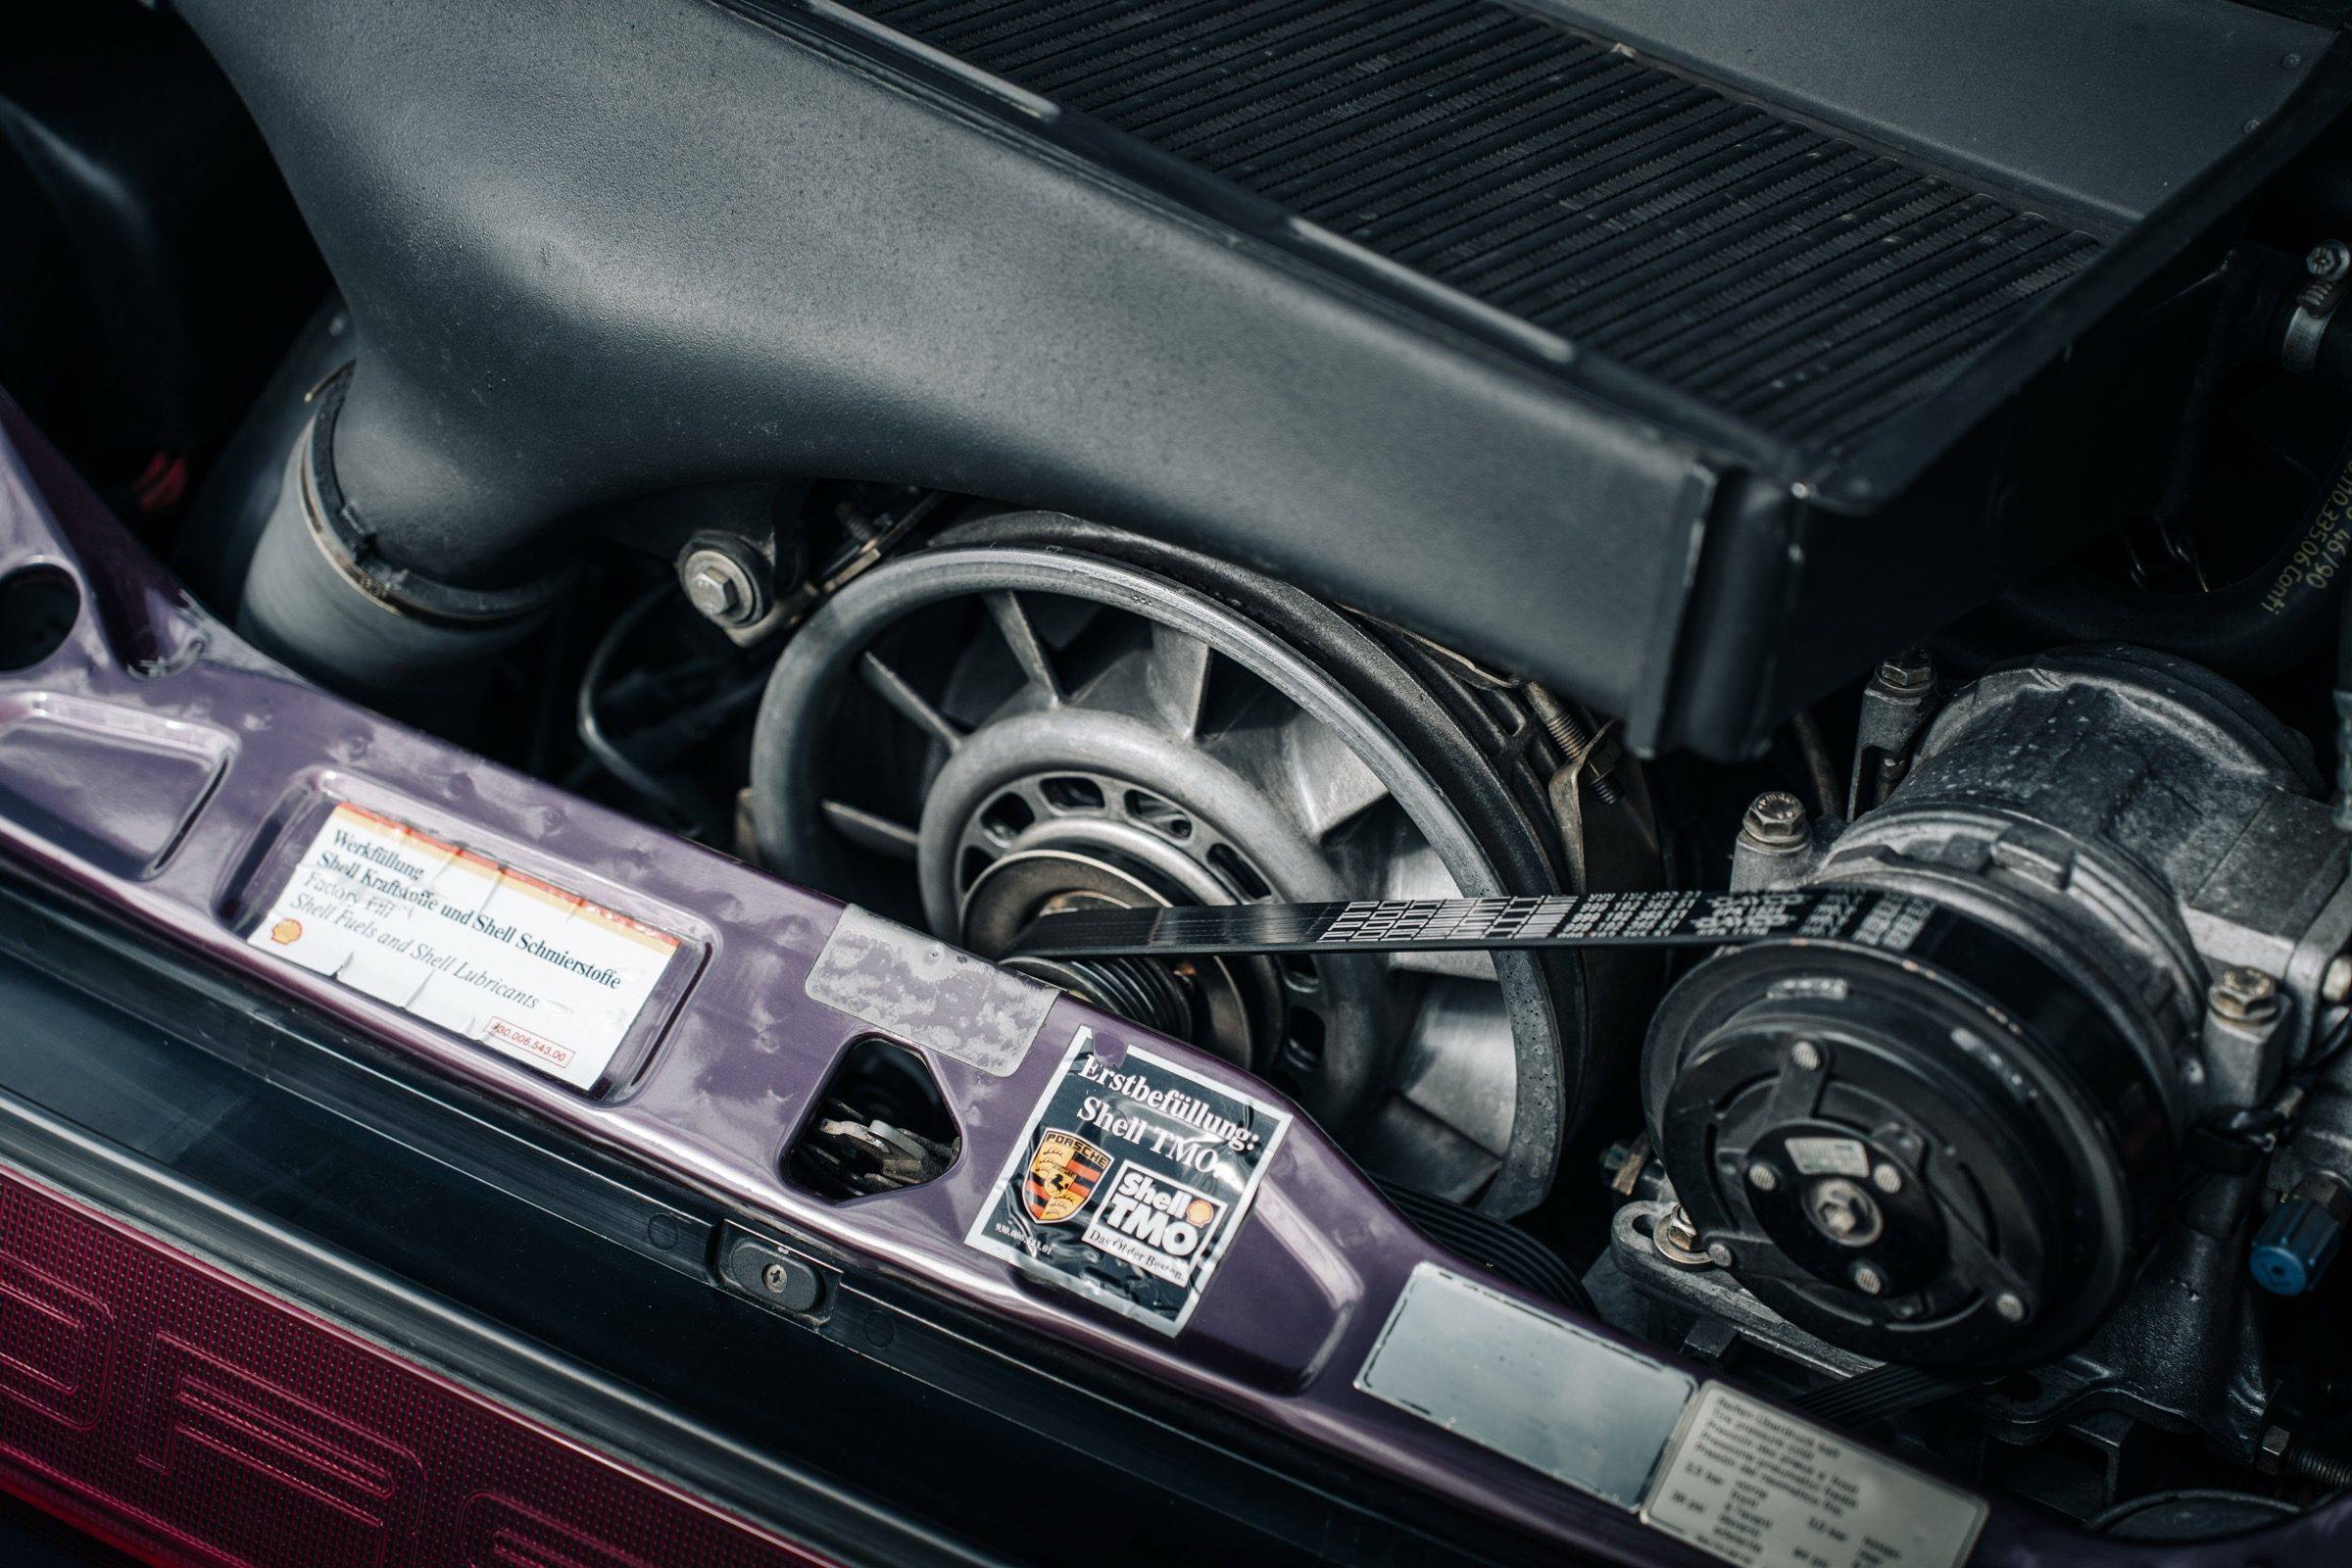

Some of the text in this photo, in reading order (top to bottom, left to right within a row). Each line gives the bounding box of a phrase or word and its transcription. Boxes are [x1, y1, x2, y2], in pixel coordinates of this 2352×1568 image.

[2306, 528, 2350, 589] 46/90
[2261, 565, 2302, 615] Conti
[332, 829, 425, 881] Werkfüllung
[317, 852, 622, 992] Shell Kraftstoffe und Shell Schmierstoffe
[290, 892, 540, 1011] Shell Fuels and Shell Lubricants
[1076, 1097, 1145, 1146] Shell
[1077, 1054, 1260, 1152] Erstbefüllung:
[1046, 1133, 1109, 1168] PORSCHE
[1118, 1171, 1193, 1219] Shell
[1089, 1229, 1111, 1246] Das
[1105, 1196, 1200, 1257] TMO
